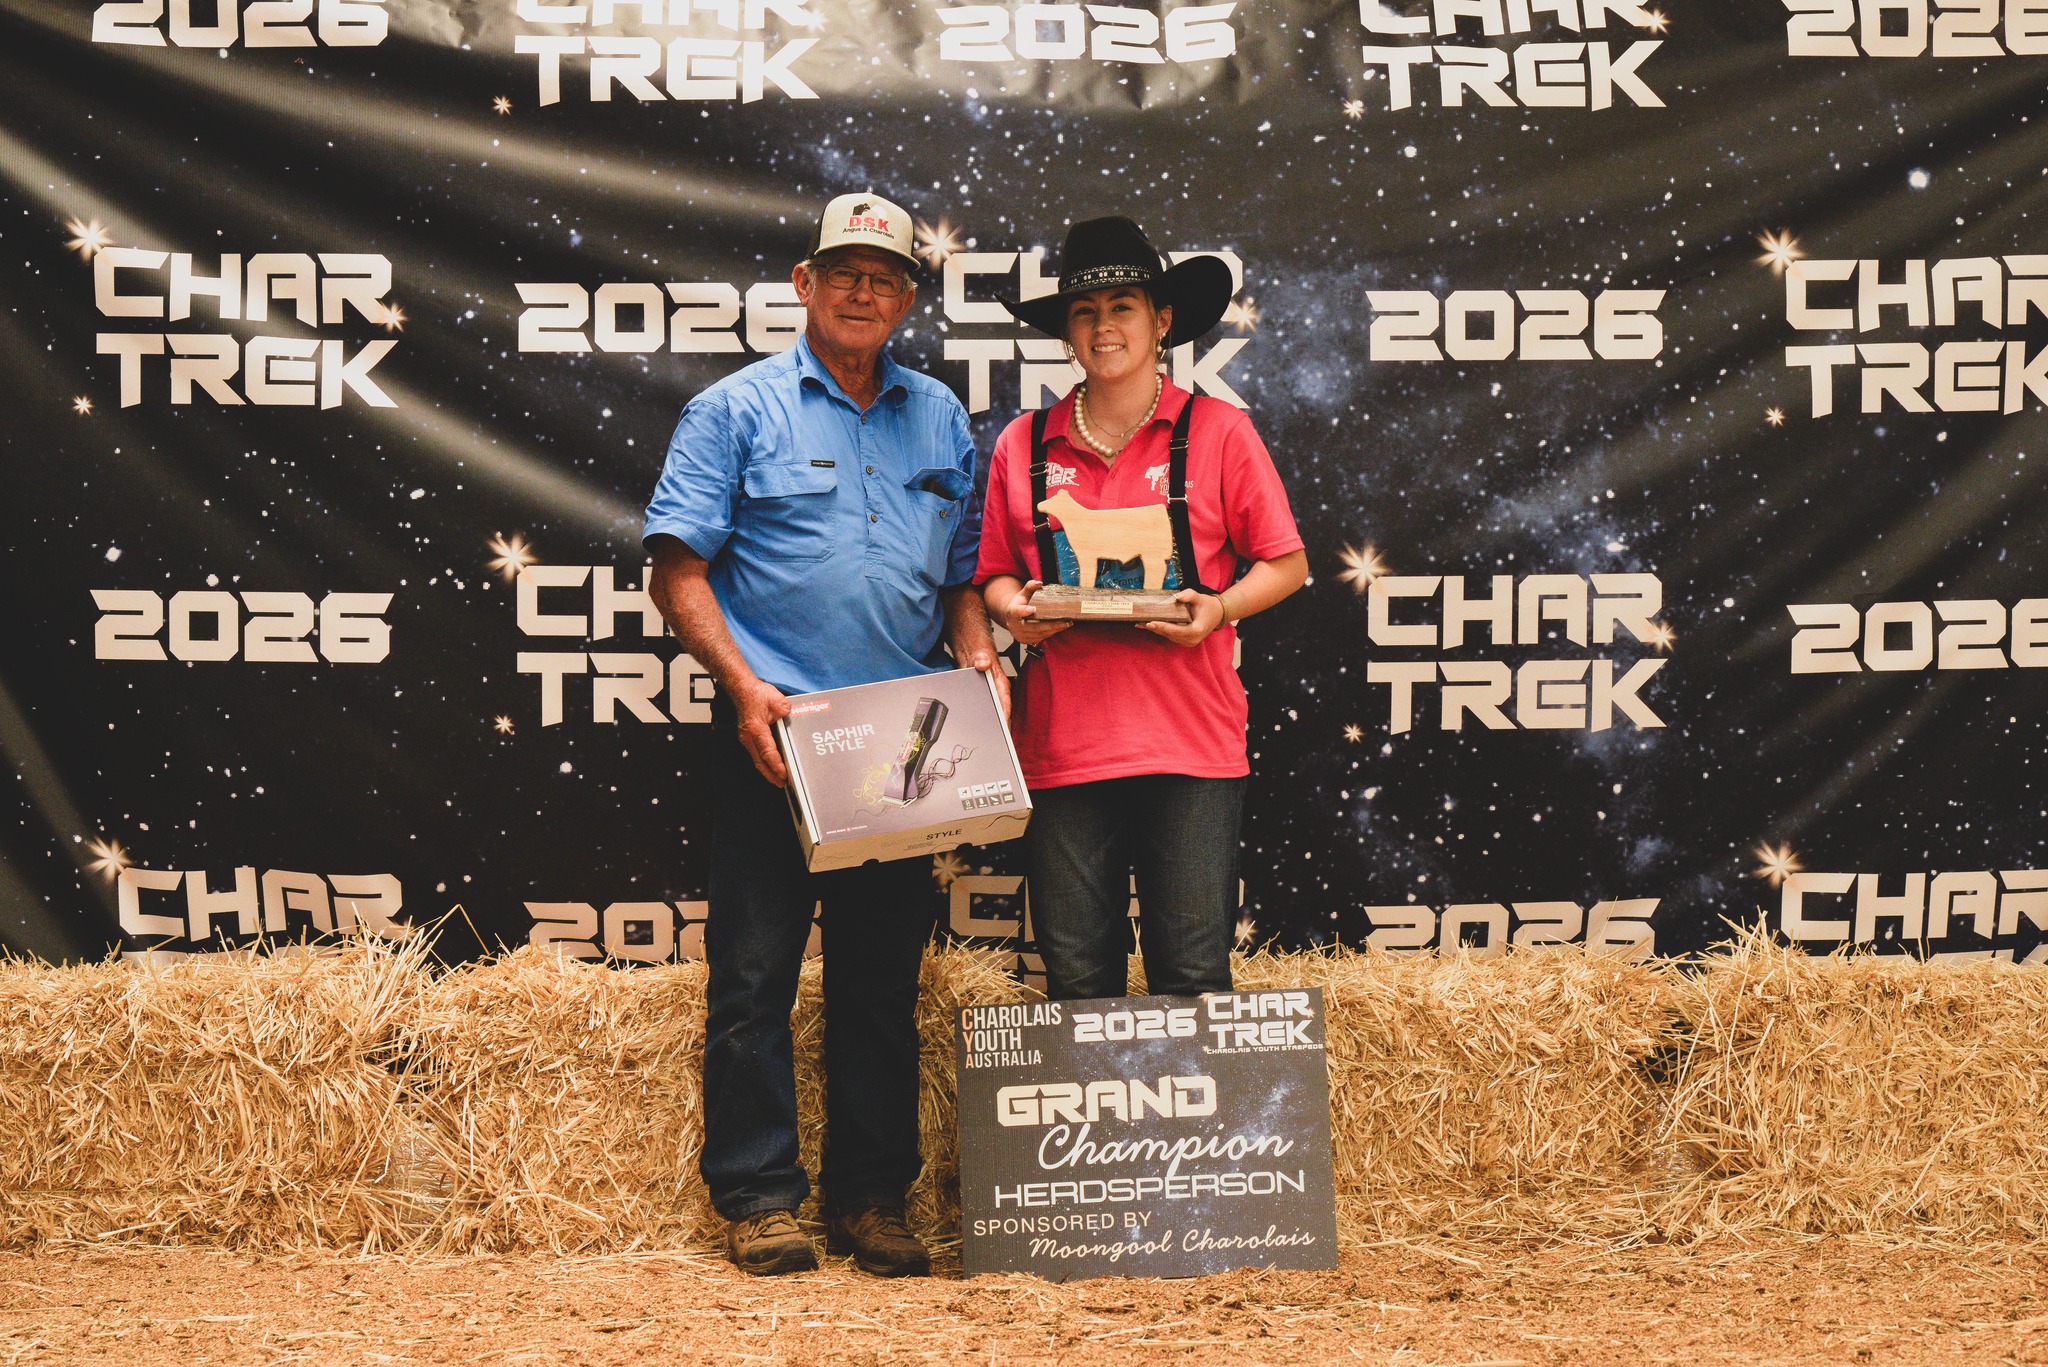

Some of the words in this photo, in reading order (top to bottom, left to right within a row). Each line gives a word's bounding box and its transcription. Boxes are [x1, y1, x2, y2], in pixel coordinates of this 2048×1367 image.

[940, 2, 1237, 63] 2026
[514, 35, 820, 107] TREK
[1362, 40, 1667, 111] TREK
[849, 216, 889, 232] DSK
[94, 248, 393, 328] CHAR
[515, 283, 806, 353] 2026
[1365, 289, 1666, 360] 2026
[96, 334, 399, 410] TREK
[90, 590, 394, 662] 2026
[1367, 573, 1663, 650] CHAR
[1367, 658, 1668, 735] TREK
[812, 724, 875, 744] SAPHIR
[816, 737, 866, 755] STYLE
[926, 829, 962, 840] STYLE
[117, 866, 404, 942] CHAR
[1364, 898, 1661, 961] 2026
[962, 1003, 1062, 1031] CHAROLAIS
[1072, 1008, 1197, 1042] 2026
[1208, 992, 1312, 1020] CHAR
[963, 1029, 1021, 1052] YOUTH
[965, 1049, 1042, 1069] AUSTRALIA
[1209, 1020, 1313, 1048] TREK
[997, 1075, 1217, 1127] GRAND
[1038, 1123, 1294, 1178] Champion
[994, 1170, 1305, 1208] HERDSPERSON
[973, 1213, 1114, 1237] SPONSORED
[1124, 1210, 1152, 1228] BY
[1028, 1230, 1172, 1262] Moongool
[1182, 1224, 1316, 1252] Charolais
